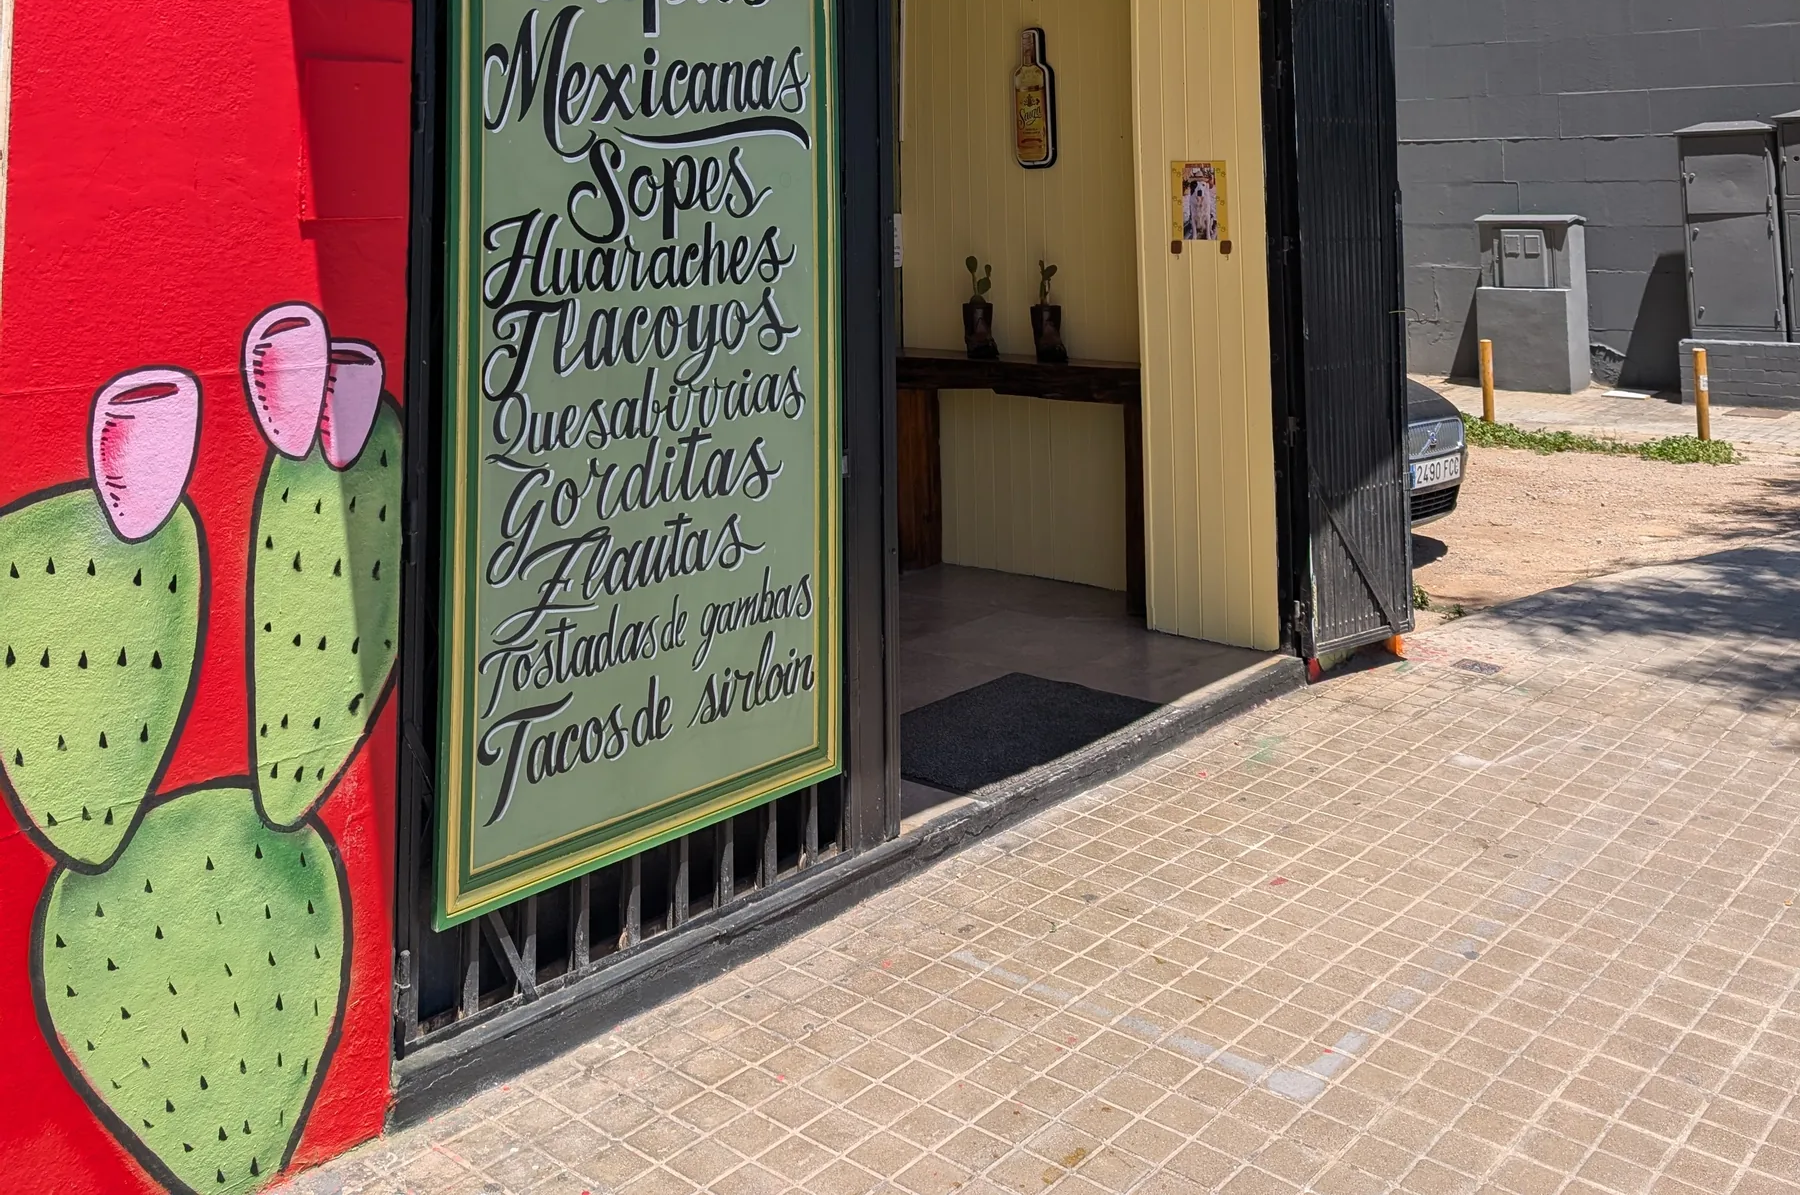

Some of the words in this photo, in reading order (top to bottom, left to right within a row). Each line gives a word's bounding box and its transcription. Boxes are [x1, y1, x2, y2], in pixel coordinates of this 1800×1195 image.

[483, 5, 812, 163] Mexicanas
[567, 138, 773, 243] Sopes
[482, 208, 797, 309] Huaraches
[481, 287, 801, 402] Tlacoyos
[485, 365, 806, 468] Quesabirrias
[1416, 461, 1441, 485] 2490
[486, 427, 784, 588] Gorditas
[490, 512, 766, 645] Flautas
[478, 604, 660, 720] Tostadas
[660, 594, 689, 653] de
[692, 566, 814, 671] gambas
[476, 691, 629, 828] Tacos
[632, 674, 674, 746] de
[687, 630, 815, 730] sirloin
